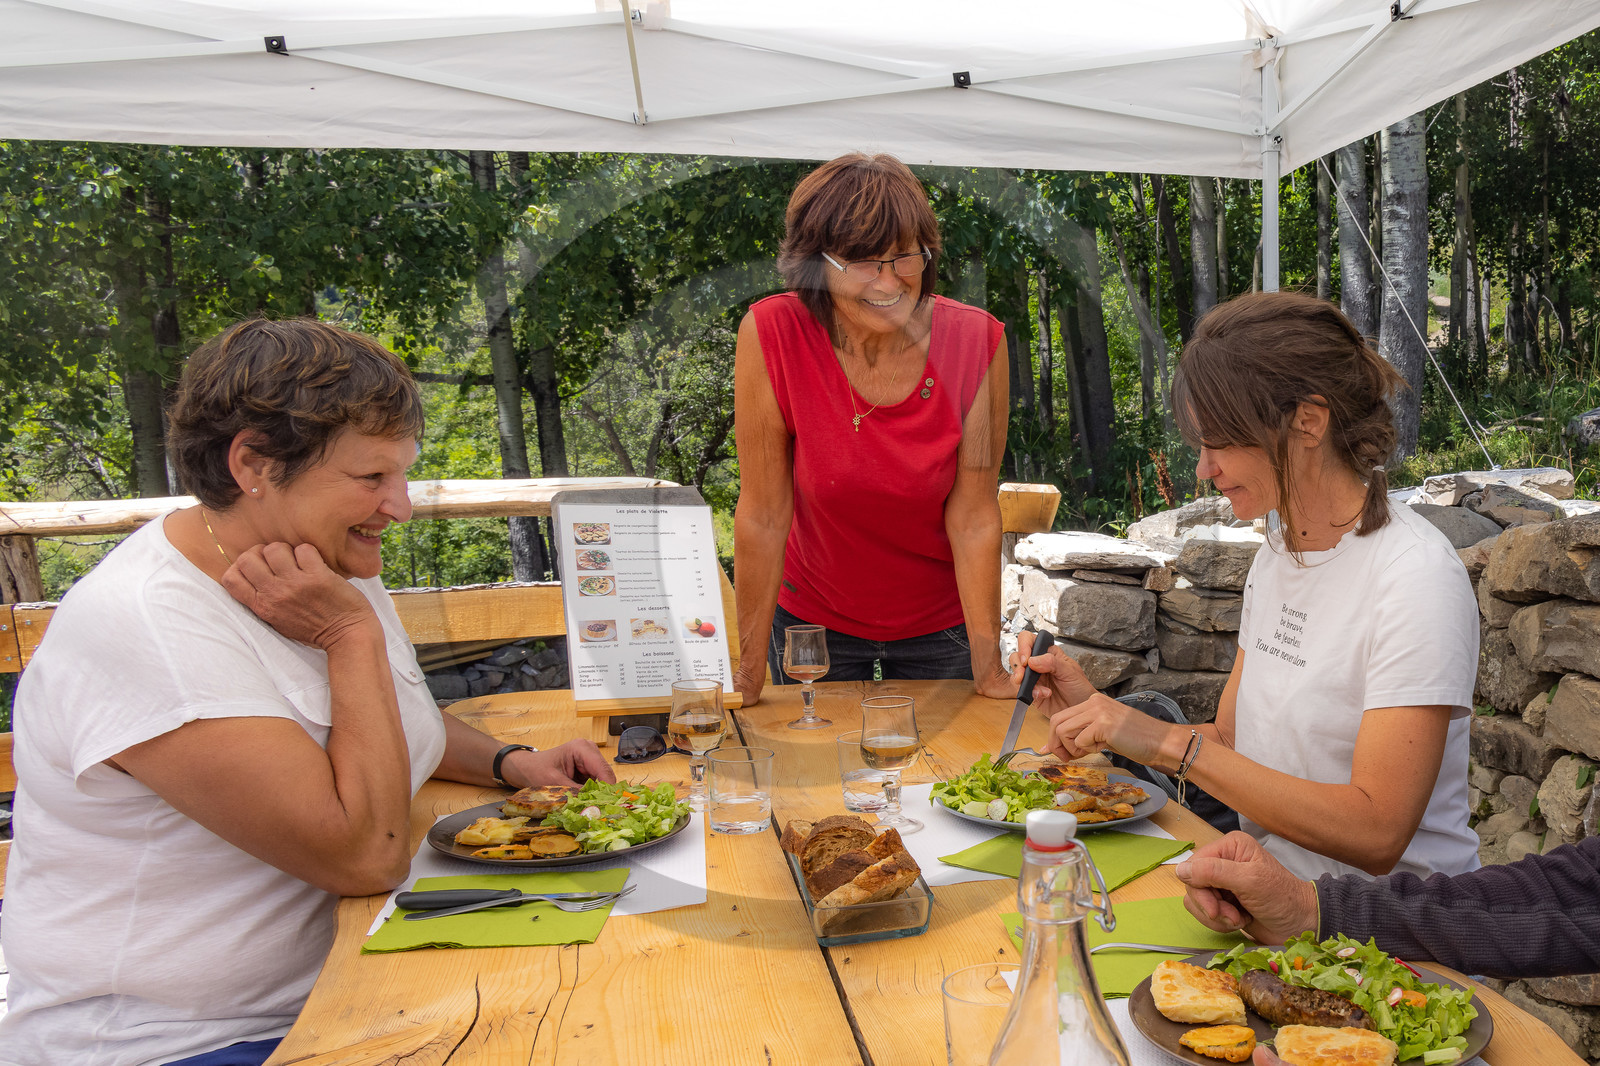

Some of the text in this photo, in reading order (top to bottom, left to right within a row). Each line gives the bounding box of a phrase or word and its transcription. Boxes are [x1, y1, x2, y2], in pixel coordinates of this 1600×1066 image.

[1281, 603, 1288, 614] Be
[1280, 616, 1304, 636] be brave,
[1274, 628, 1282, 641] be
[1255, 637, 1269, 653] You
[1269, 646, 1280, 657] are
